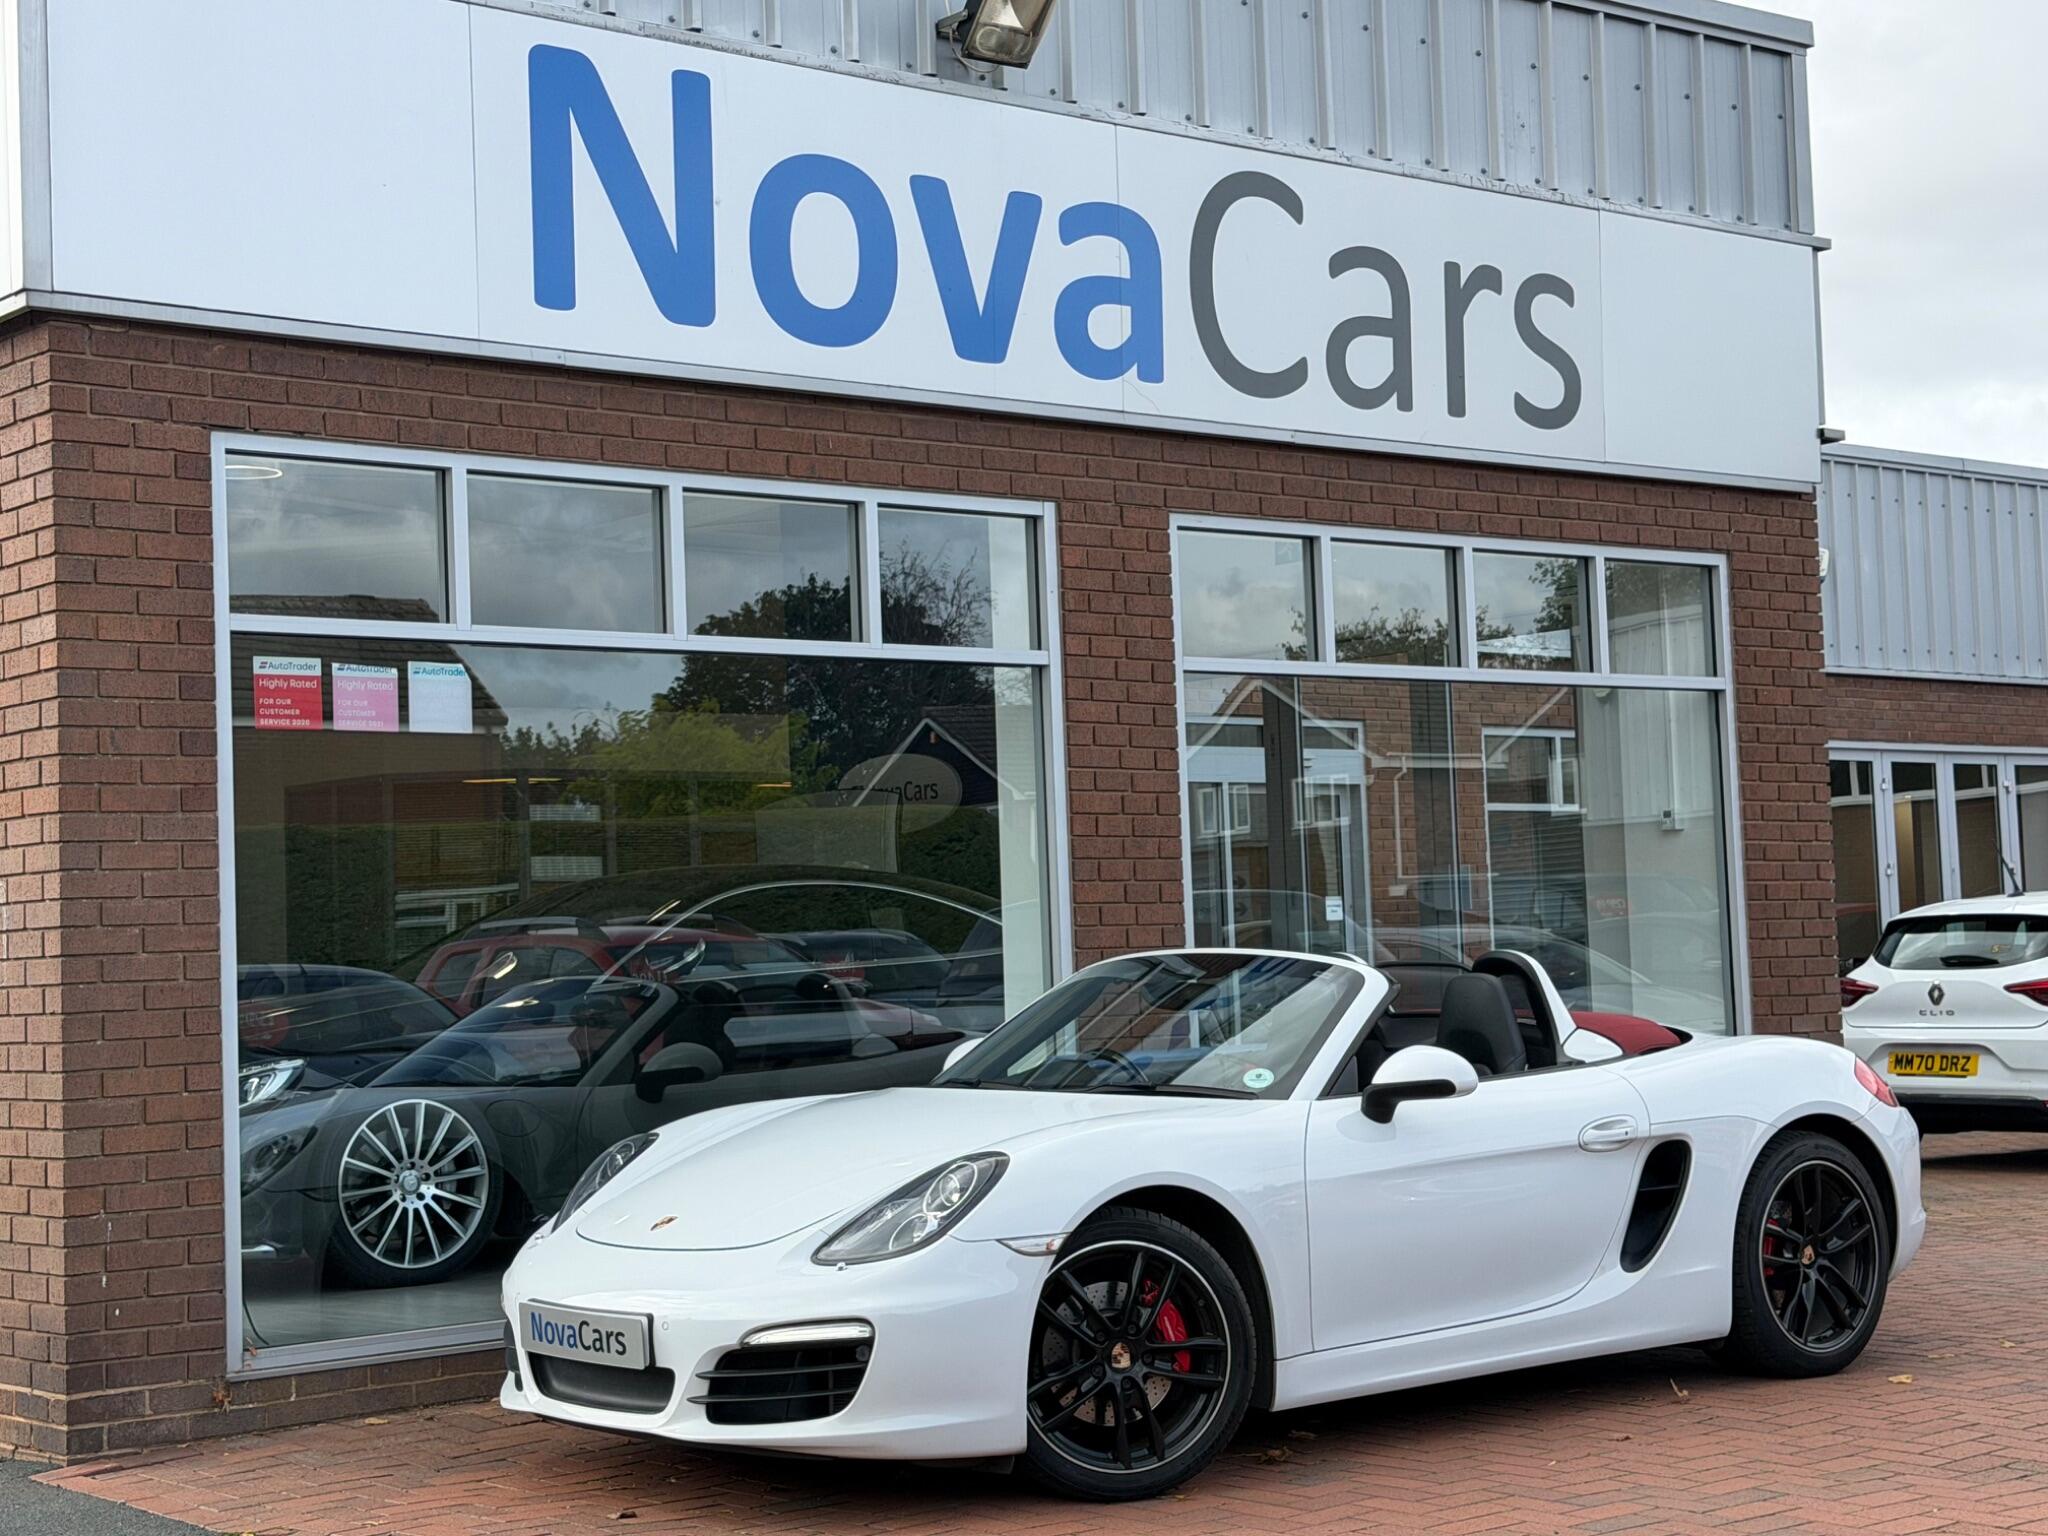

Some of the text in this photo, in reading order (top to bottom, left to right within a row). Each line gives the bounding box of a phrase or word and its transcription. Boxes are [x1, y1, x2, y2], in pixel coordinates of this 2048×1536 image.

[528, 43, 1582, 430] NovaCars
[269, 661, 317, 671] AutoTrader
[259, 678, 317, 690] Highly Rated
[337, 680, 393, 691] Highly Rated
[1894, 1054, 1971, 1072] MM70 DRZ
[530, 1311, 627, 1356] NovaCars
